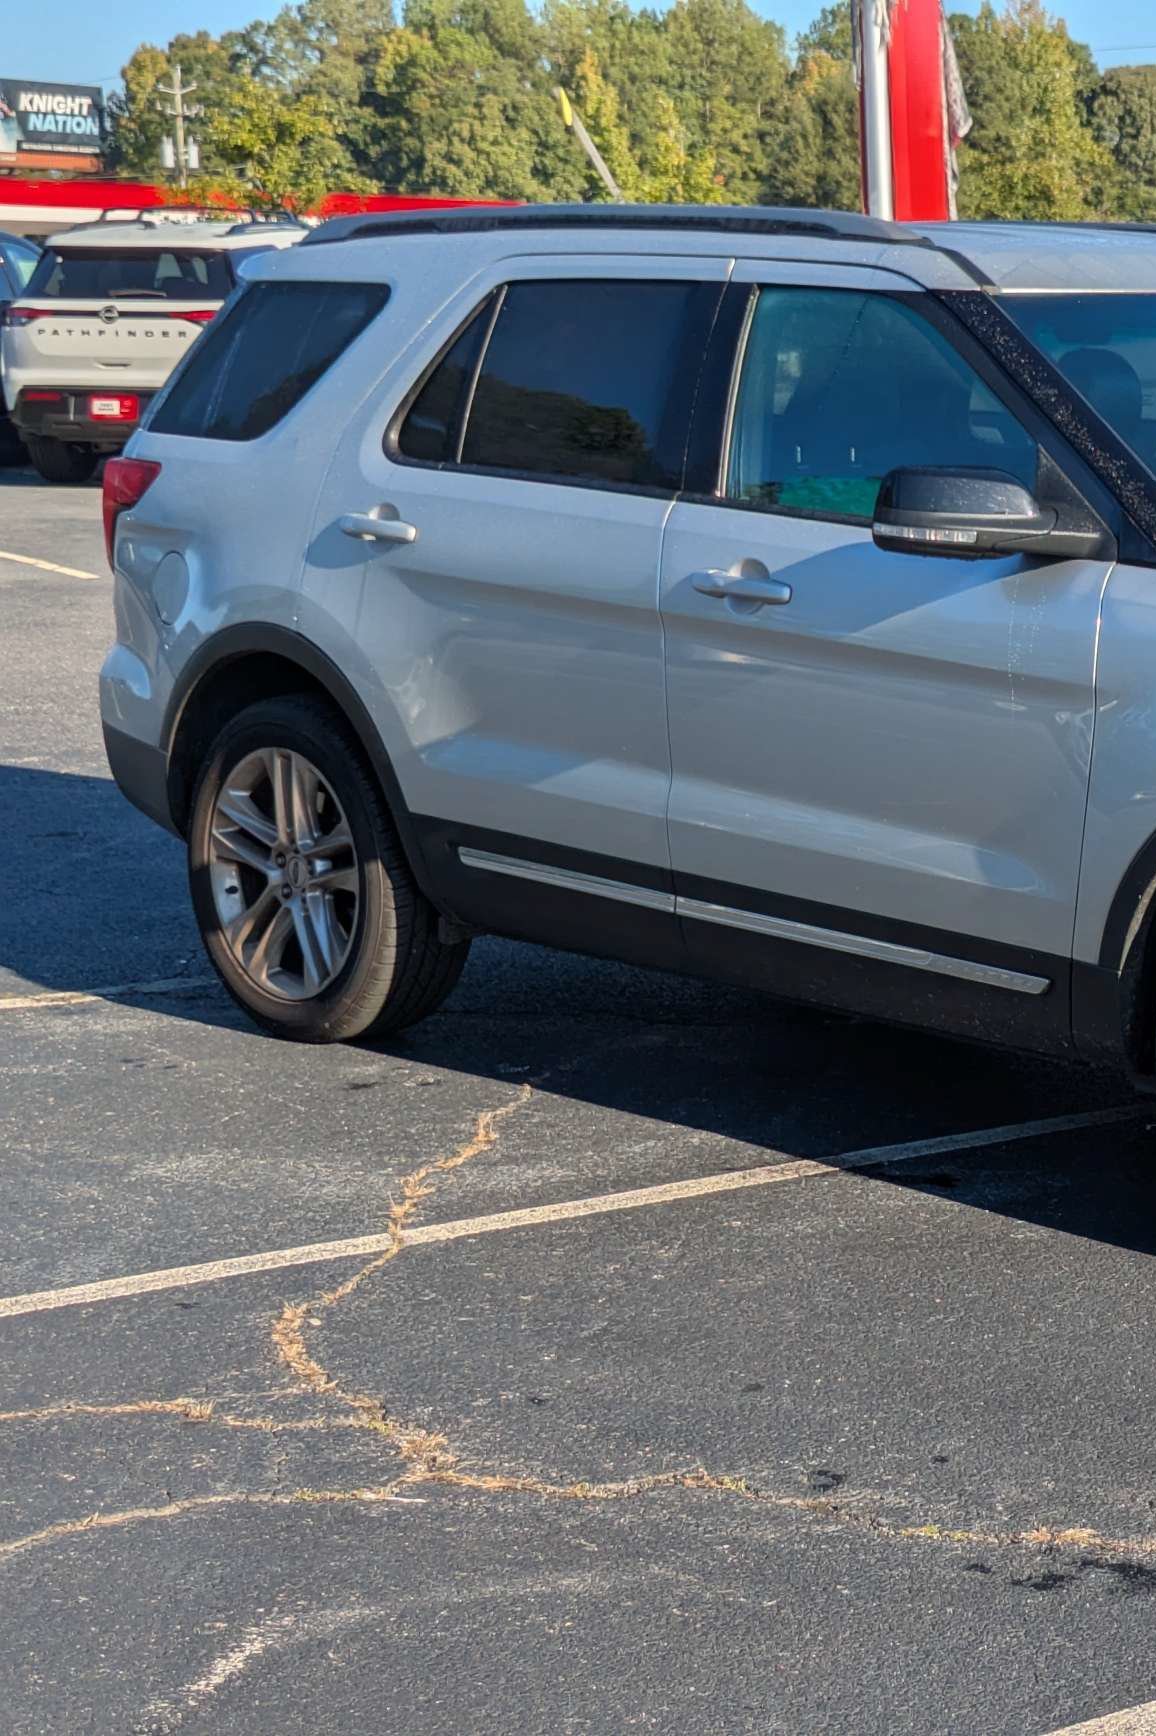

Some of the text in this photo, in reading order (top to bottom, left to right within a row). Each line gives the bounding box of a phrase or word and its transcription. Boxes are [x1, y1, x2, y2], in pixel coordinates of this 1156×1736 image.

[20, 91, 92, 116] KNIGHT
[28, 112, 99, 136] NATION
[37, 328, 188, 338] PATHFINDER
